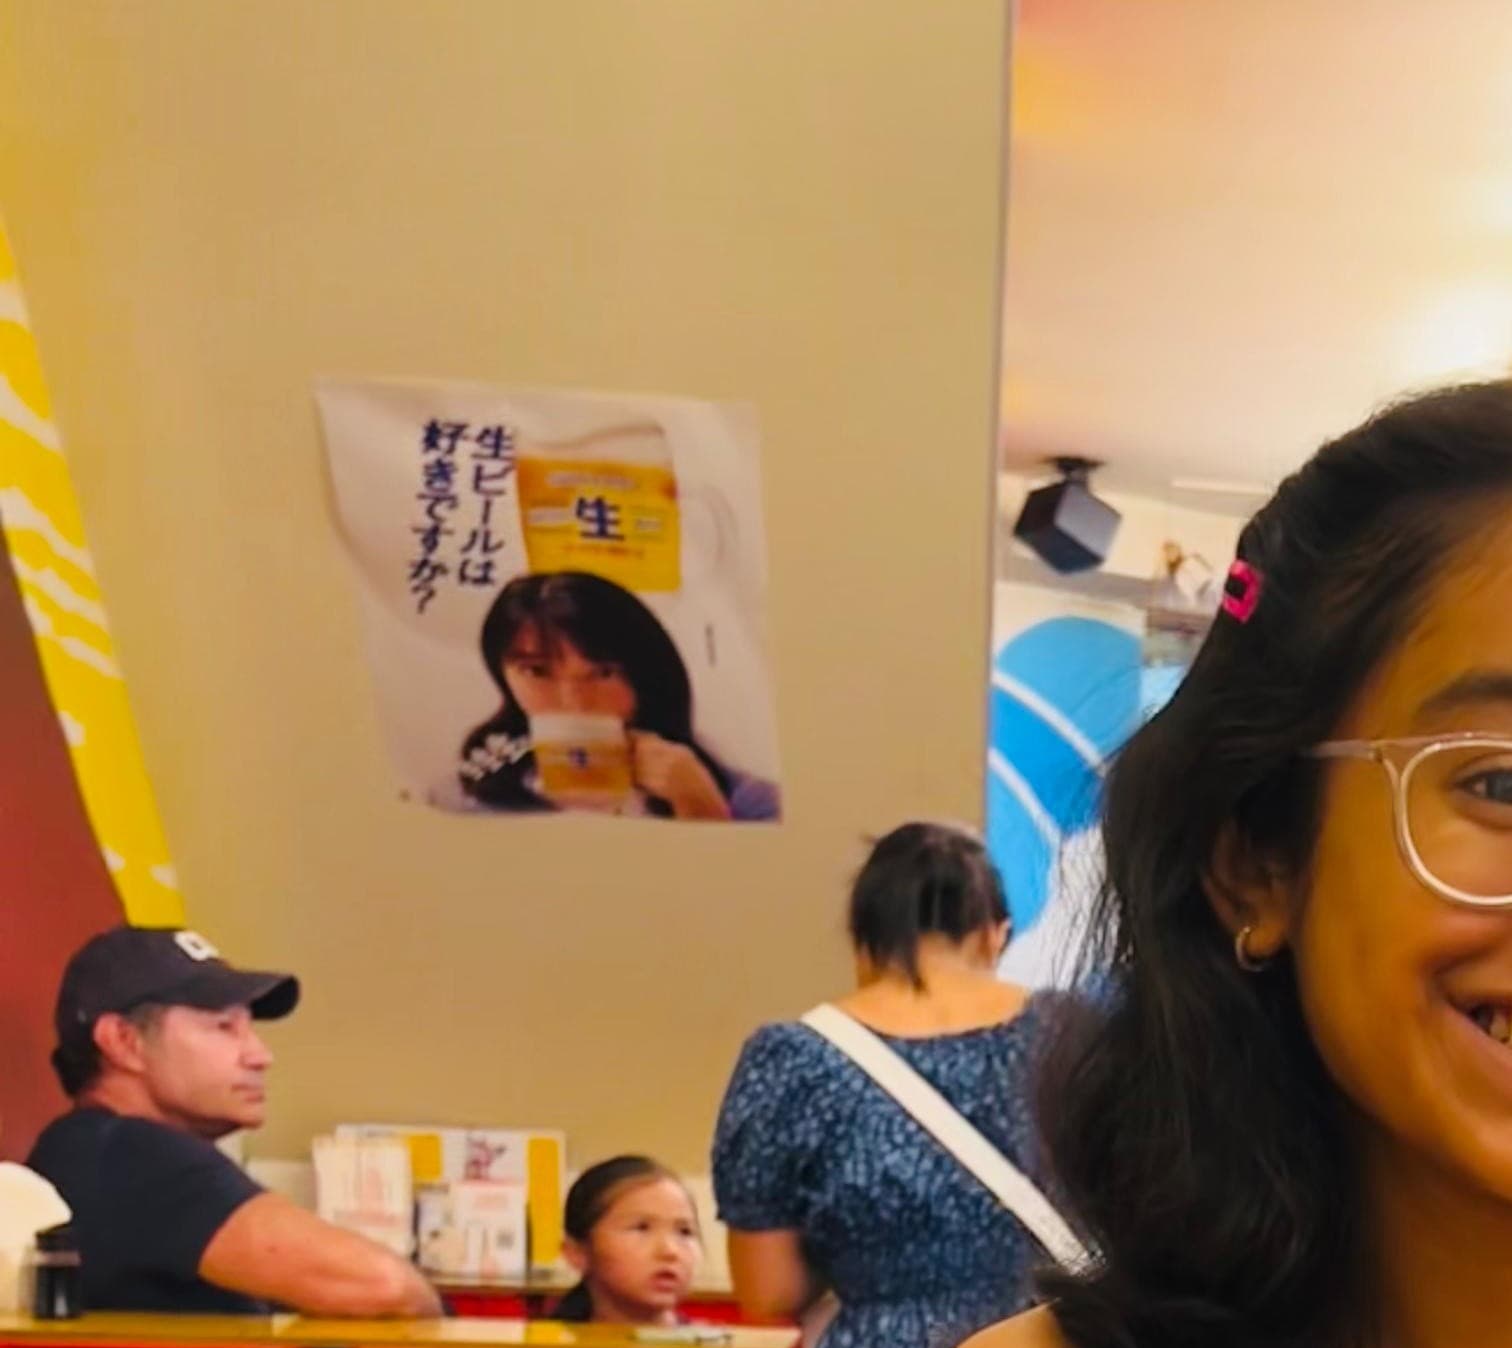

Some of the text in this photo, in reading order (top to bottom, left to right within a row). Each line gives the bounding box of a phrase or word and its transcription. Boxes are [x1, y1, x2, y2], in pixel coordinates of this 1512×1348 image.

[458, 425, 516, 587] 生ビールは
[575, 496, 626, 542] 生
